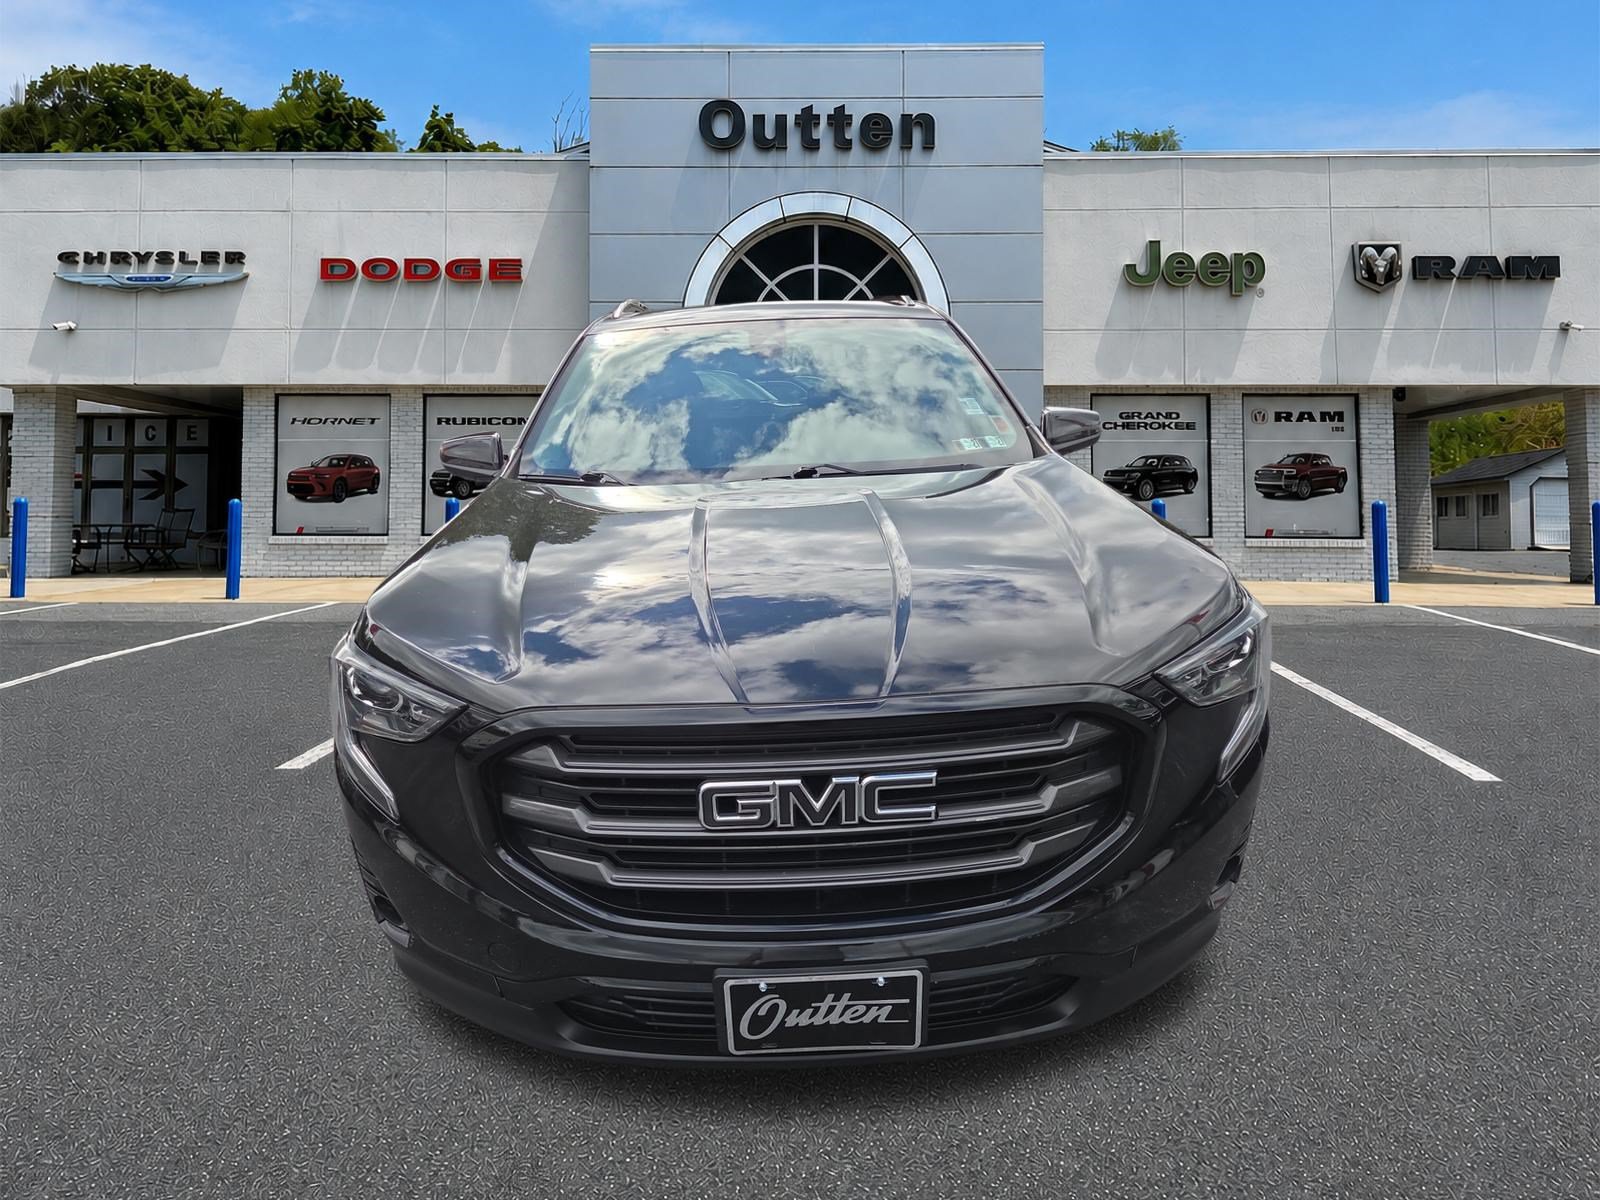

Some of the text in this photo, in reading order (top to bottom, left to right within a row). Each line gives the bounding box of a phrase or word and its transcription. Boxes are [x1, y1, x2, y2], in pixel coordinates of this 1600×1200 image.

[698, 99, 936, 150] Outten
[57, 250, 246, 267] CHRYSLER
[1123, 239, 1266, 296] Jeep
[1412, 255, 1561, 280] RAM
[320, 257, 523, 282] DODGE
[290, 416, 381, 426] HORNET
[436, 416, 529, 426] RUBICON
[1102, 421, 1196, 430] CHEROKEE
[1118, 411, 1181, 421] GRAND
[1274, 411, 1345, 422] RAM
[698, 771, 937, 830] GMC
[739, 993, 910, 1040] Outten
